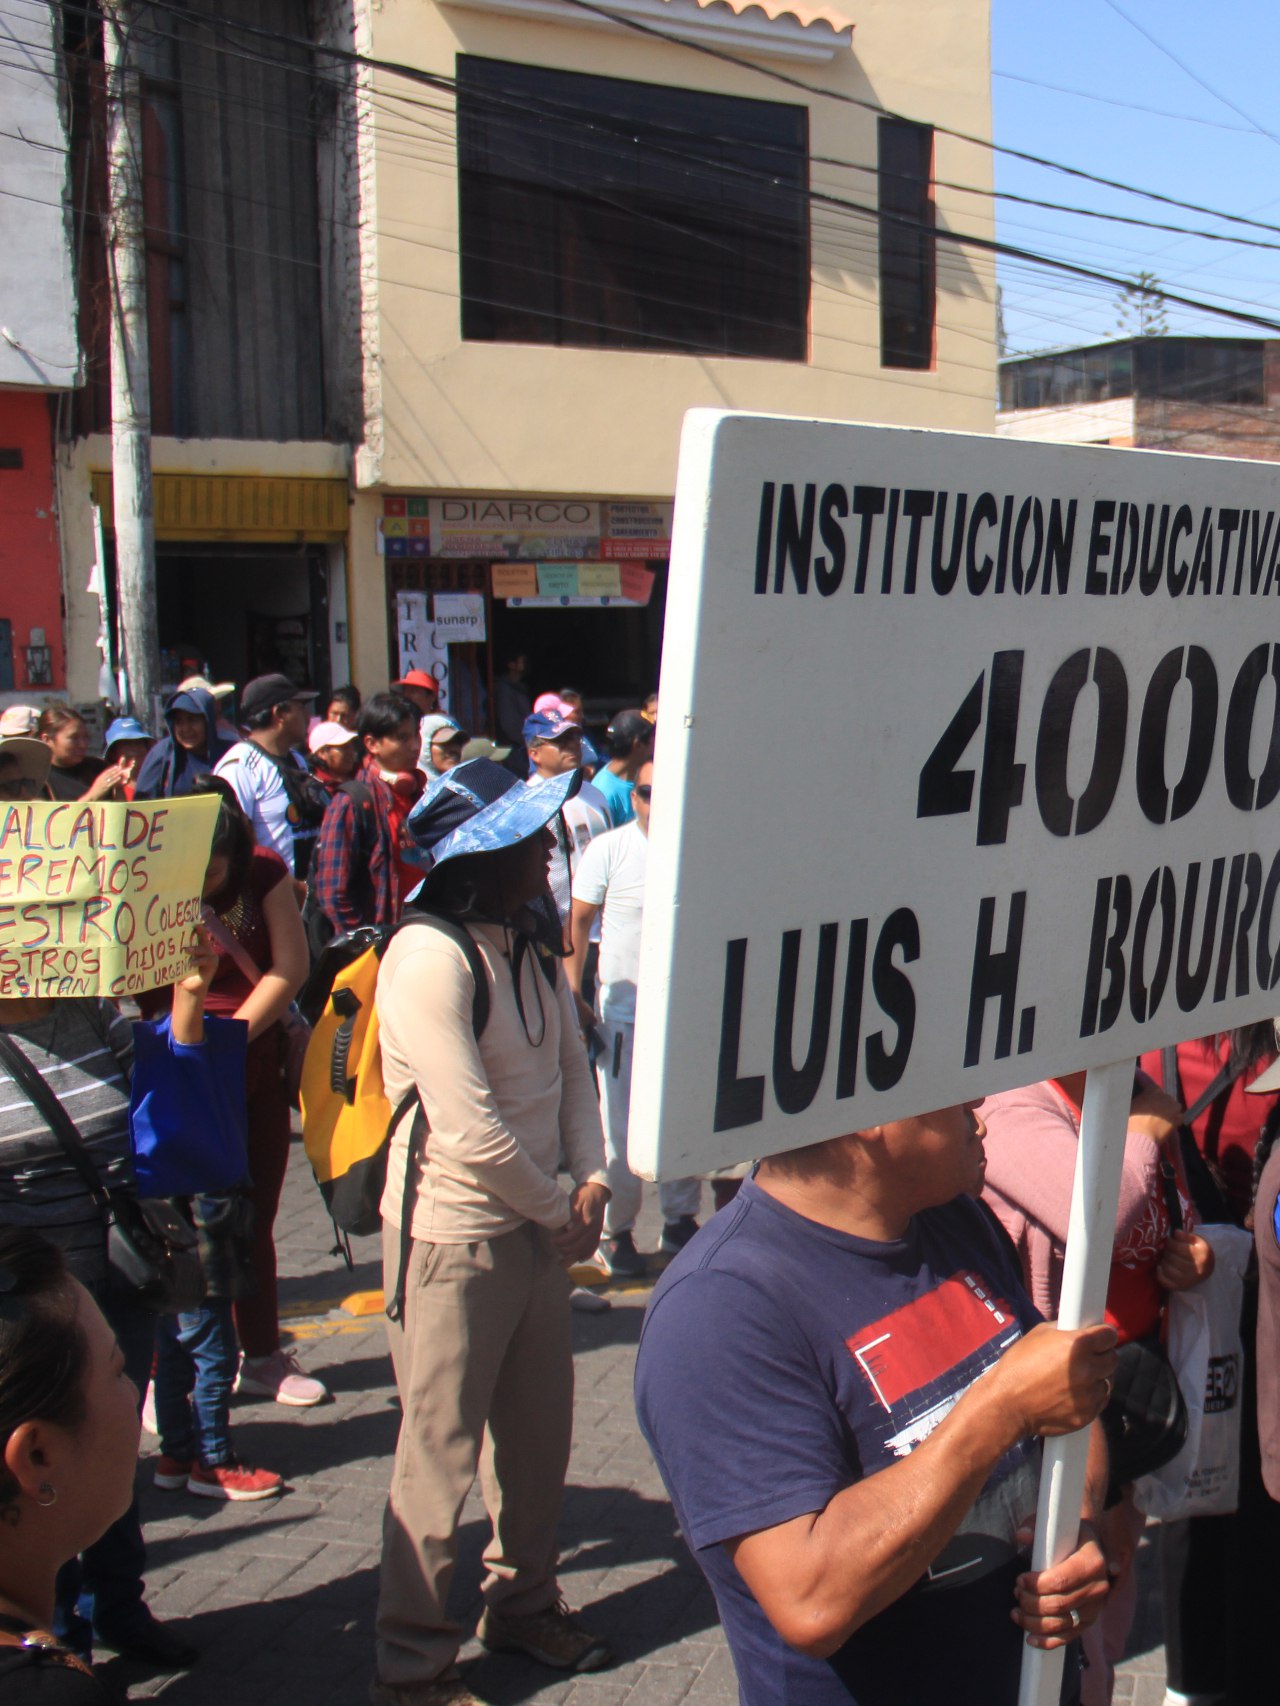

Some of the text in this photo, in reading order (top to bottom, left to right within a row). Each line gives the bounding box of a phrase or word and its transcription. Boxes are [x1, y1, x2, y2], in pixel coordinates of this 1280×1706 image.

[441, 501, 591, 524] DIARCO
[754, 481, 1079, 597] INSTITUCION
[436, 616, 478, 627] sunarp
[0, 804, 169, 852] ALCALDE
[109, 973, 145, 996] CON
[713, 906, 921, 1134] LUIS
[963, 891, 1037, 1068] H.
